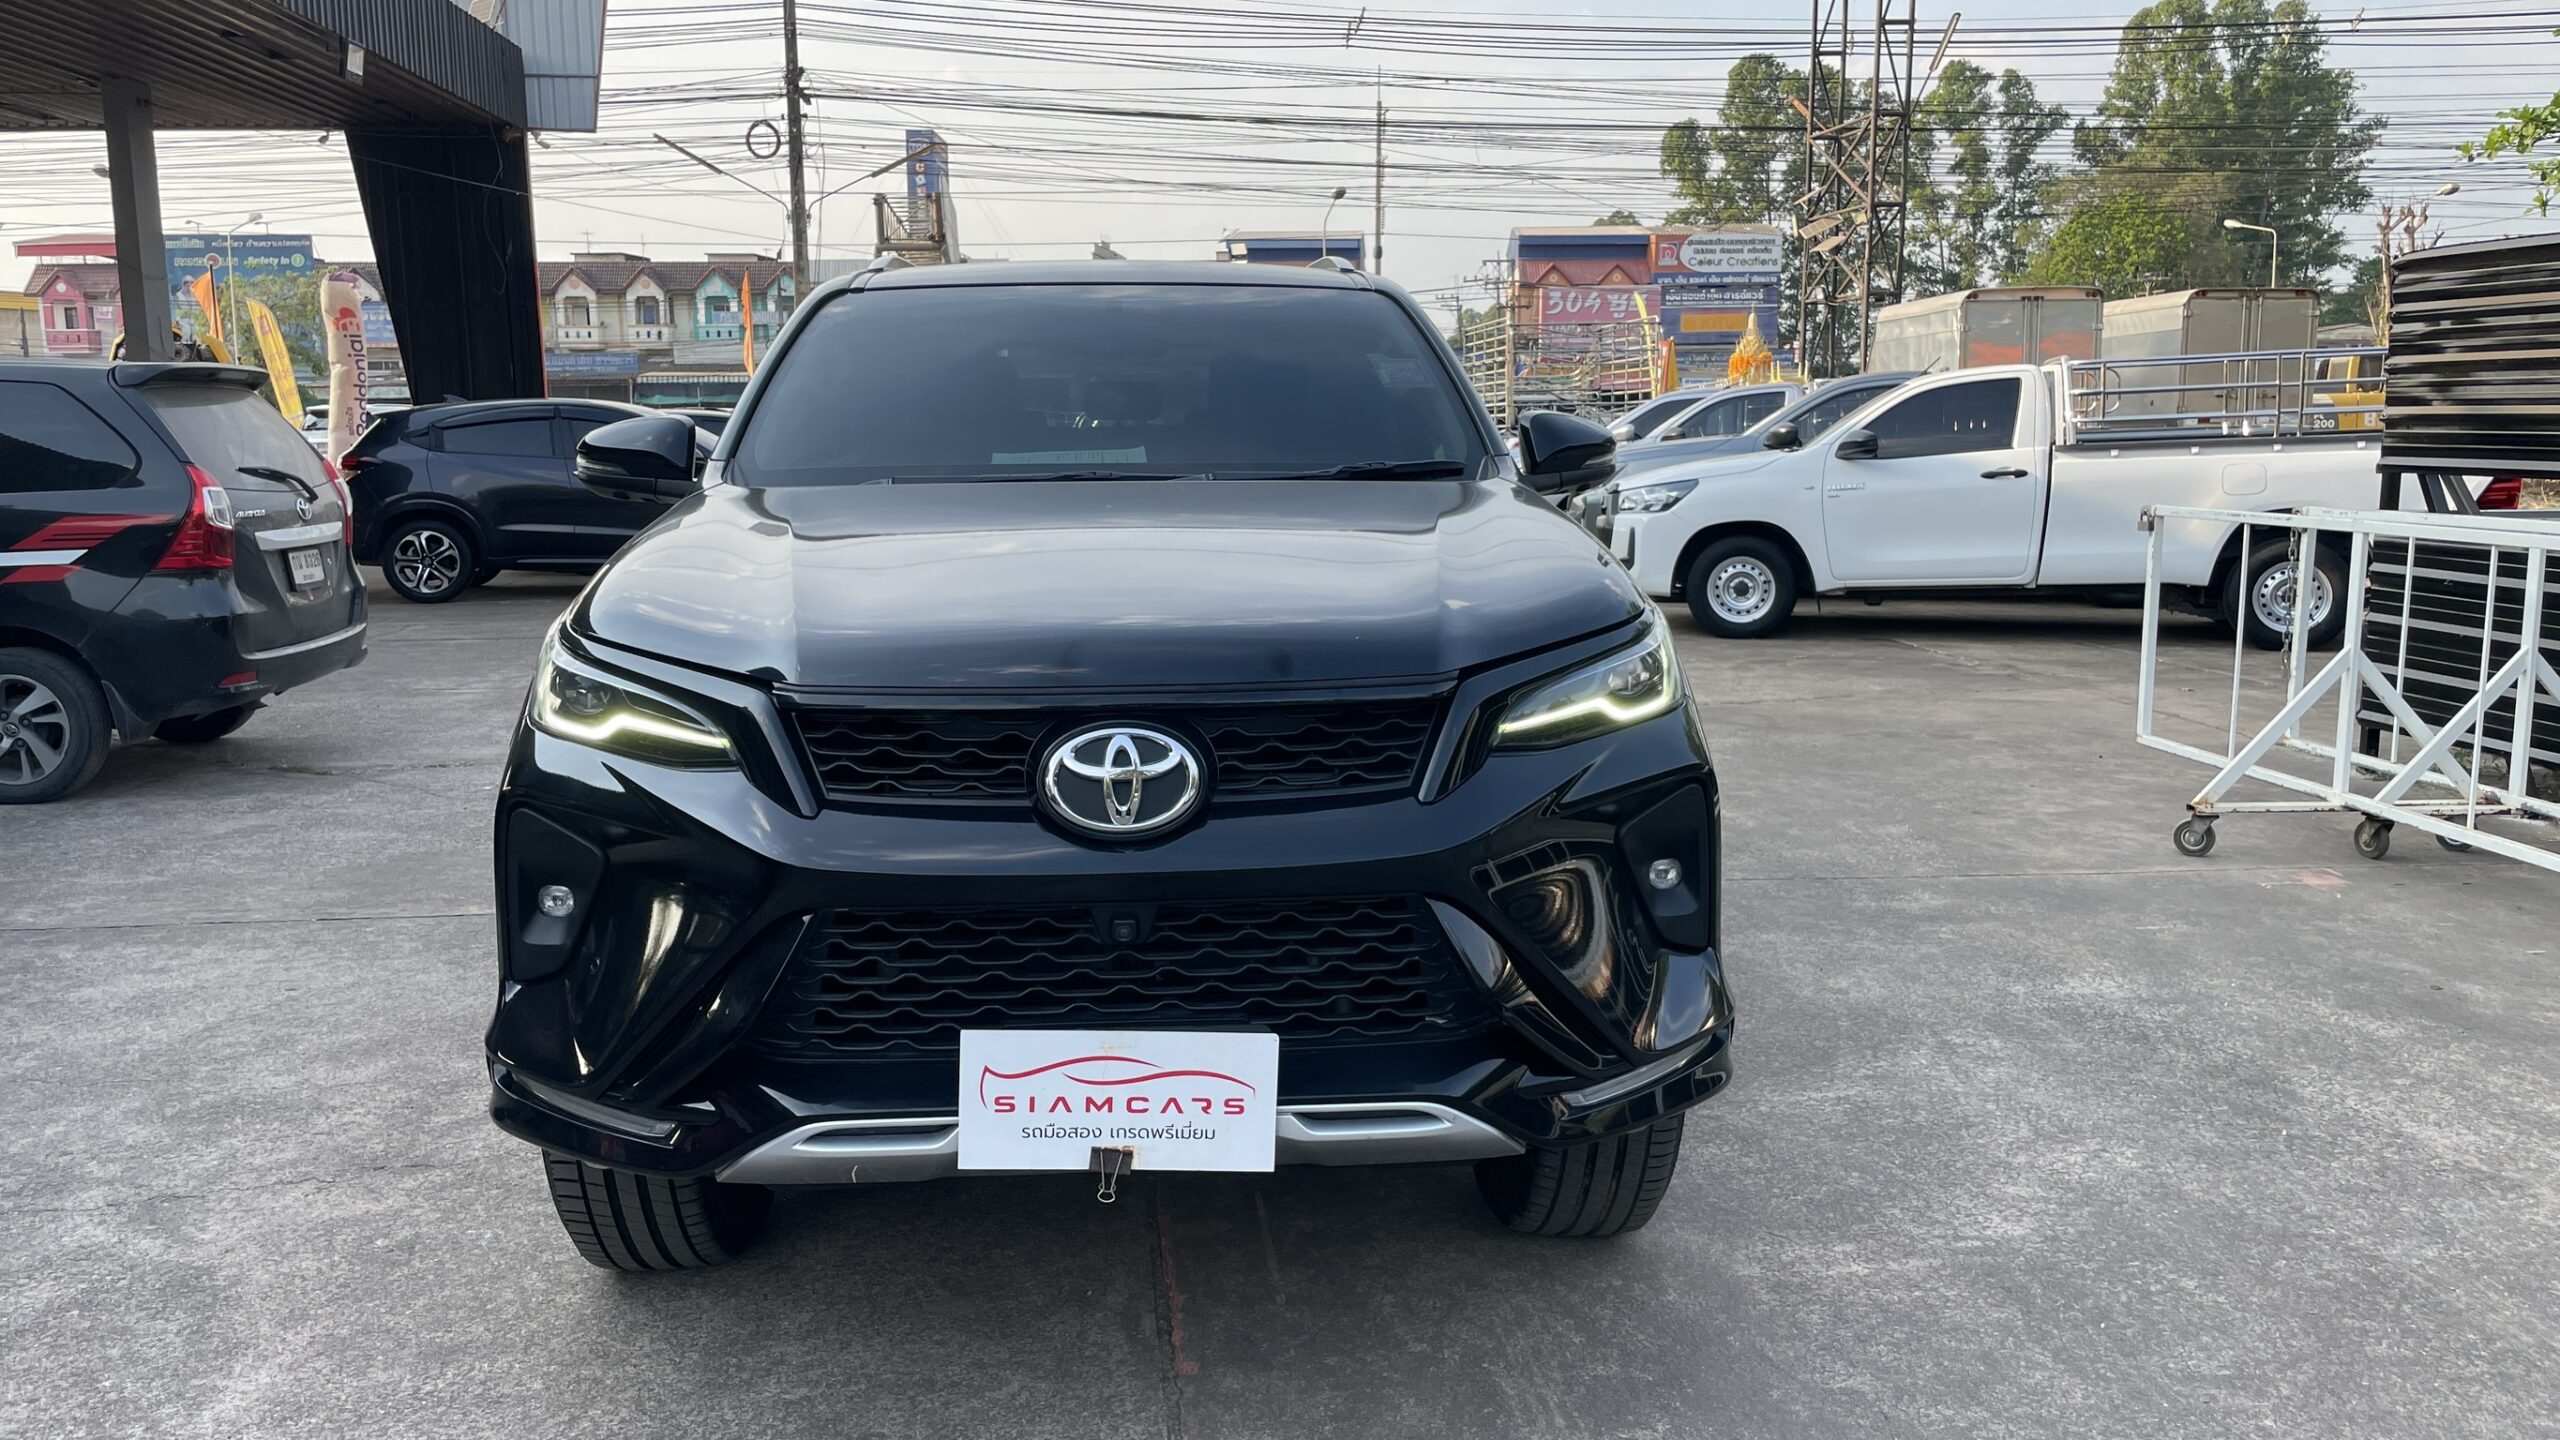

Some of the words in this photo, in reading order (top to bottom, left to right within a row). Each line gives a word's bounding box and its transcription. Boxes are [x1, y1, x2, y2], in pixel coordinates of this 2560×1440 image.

[1688, 256, 1724, 267] Colour
[1726, 256, 1778, 267] Creations
[1545, 291, 1601, 315] 304
[2313, 419, 2336, 429] 200
[993, 1095, 1246, 1116] SIAMCARS
[1021, 1122, 1103, 1140] รถมือสอง
[1110, 1121, 1217, 1141] เกรดพรีเมี่ยม
